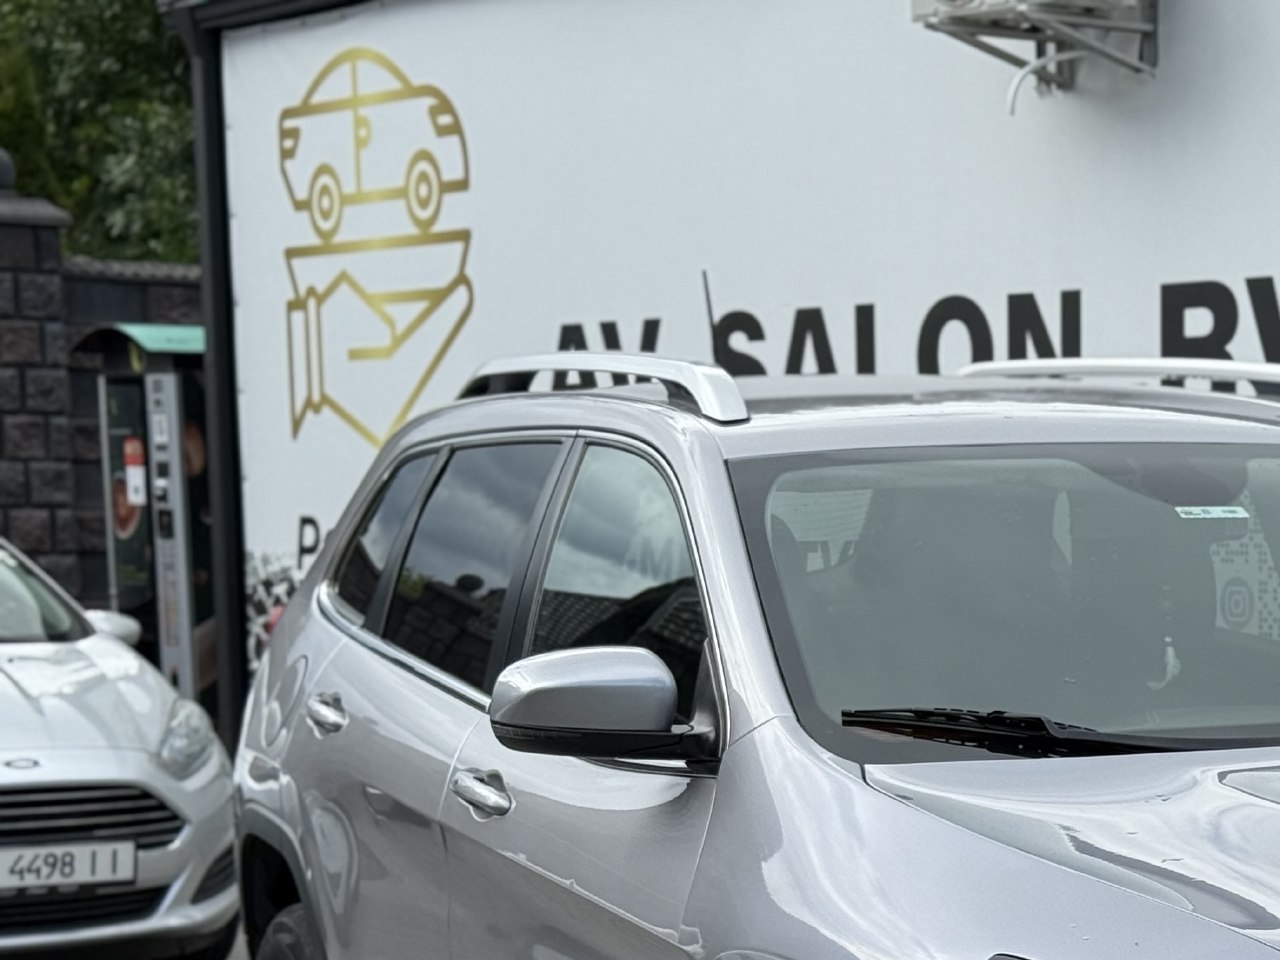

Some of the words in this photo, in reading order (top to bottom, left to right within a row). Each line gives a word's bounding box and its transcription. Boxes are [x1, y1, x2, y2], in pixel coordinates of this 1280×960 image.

[551, 318, 661, 391] AV
[711, 290, 1082, 377] SALON
[9, 851, 76, 881] 4498
